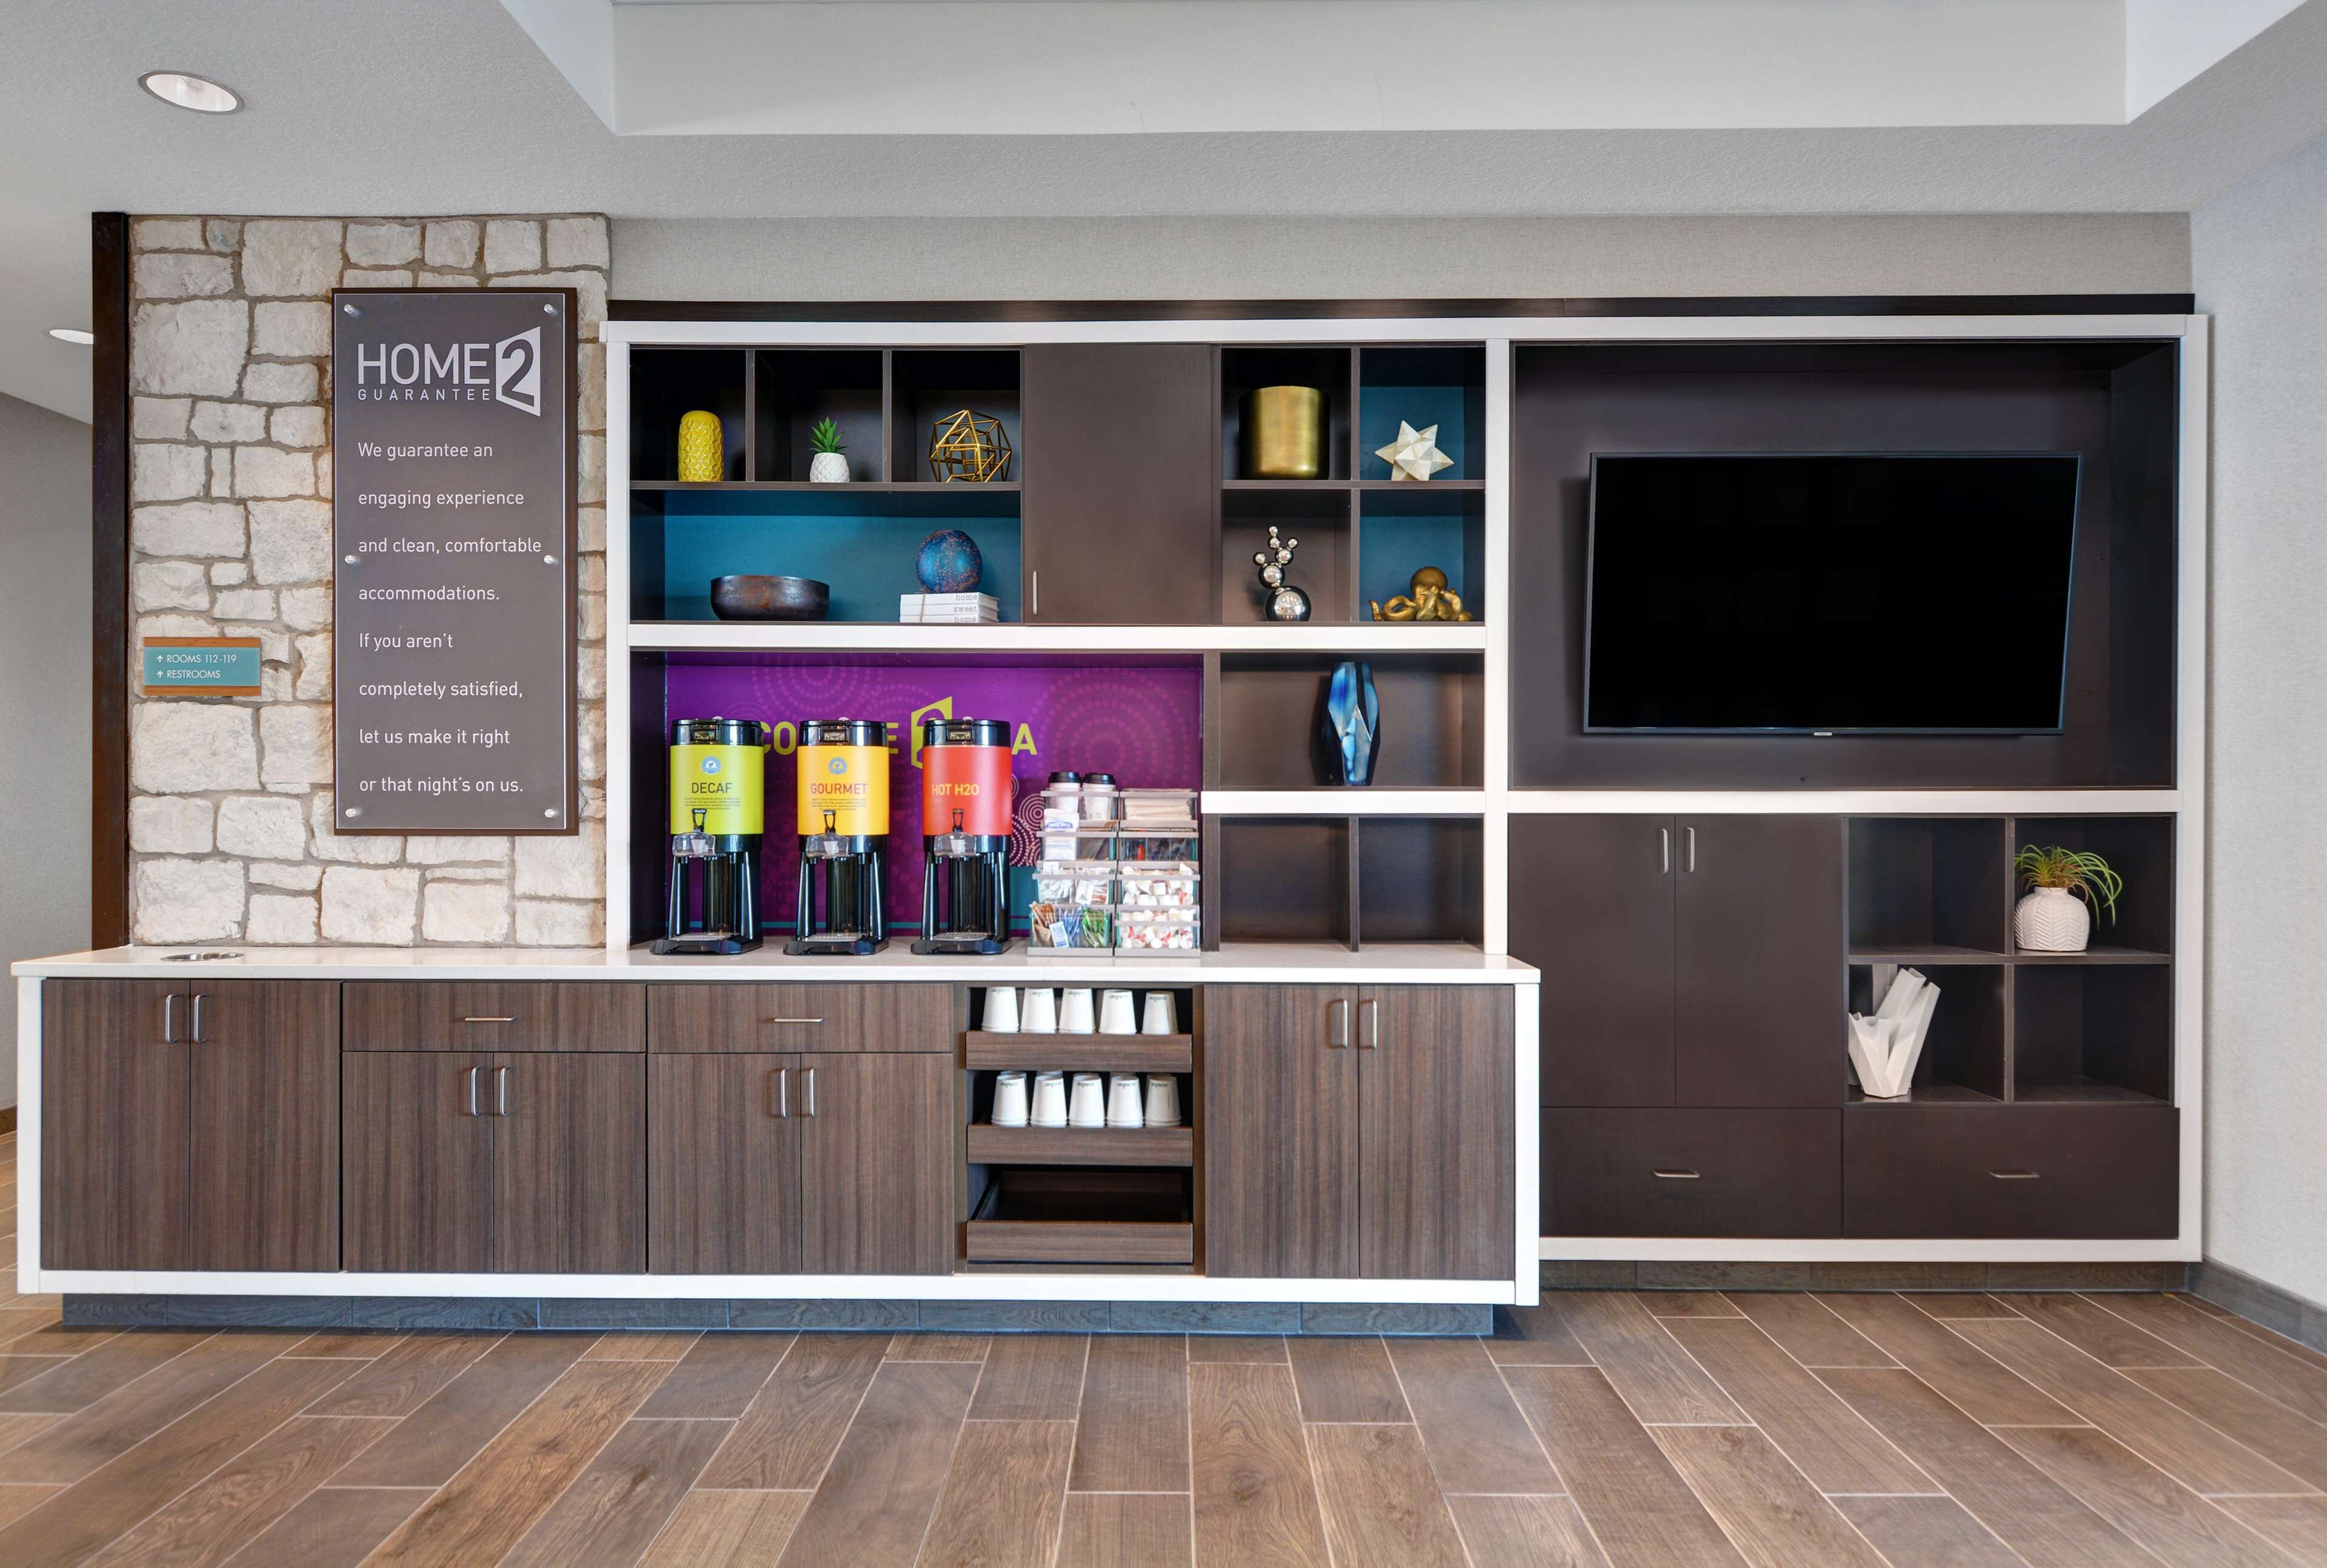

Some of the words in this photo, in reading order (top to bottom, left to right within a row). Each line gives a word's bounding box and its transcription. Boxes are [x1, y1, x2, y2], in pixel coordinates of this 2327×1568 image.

[358, 343, 490, 384] HOME
[358, 389, 490, 401] GUARANTEE
[358, 442, 382, 457] We
[387, 443, 469, 461] guarantee
[473, 446, 492, 457] an
[358, 490, 431, 509] engaging
[436, 490, 524, 509] experience
[358, 538, 387, 553] and
[393, 538, 439, 555] clean,
[445, 537, 541, 553] comfortable
[359, 585, 499, 601] accommodations.
[359, 633, 370, 648] If
[373, 637, 401, 652] you
[406, 633, 453, 648] aren't
[166, 654, 201, 664] ROOMS
[205, 654, 237, 664] 112-119
[166, 669, 221, 679] RESTROOMS
[359, 681, 446, 699] completely
[450, 681, 522, 698] satisfied,
[359, 729, 379, 744] let
[384, 733, 403, 744] us
[409, 729, 452, 744] make
[457, 729, 467, 744] it
[472, 729, 510, 748] right
[359, 780, 377, 792] or
[381, 776, 413, 792] that
[418, 776, 470, 796] night's
[475, 781, 495, 792] on
[500, 781, 523, 792] us.
[691, 782, 733, 794] DECAF
[810, 782, 868, 795] GOURMET
[930, 783, 952, 796] HOT
[954, 783, 980, 796] H2O
